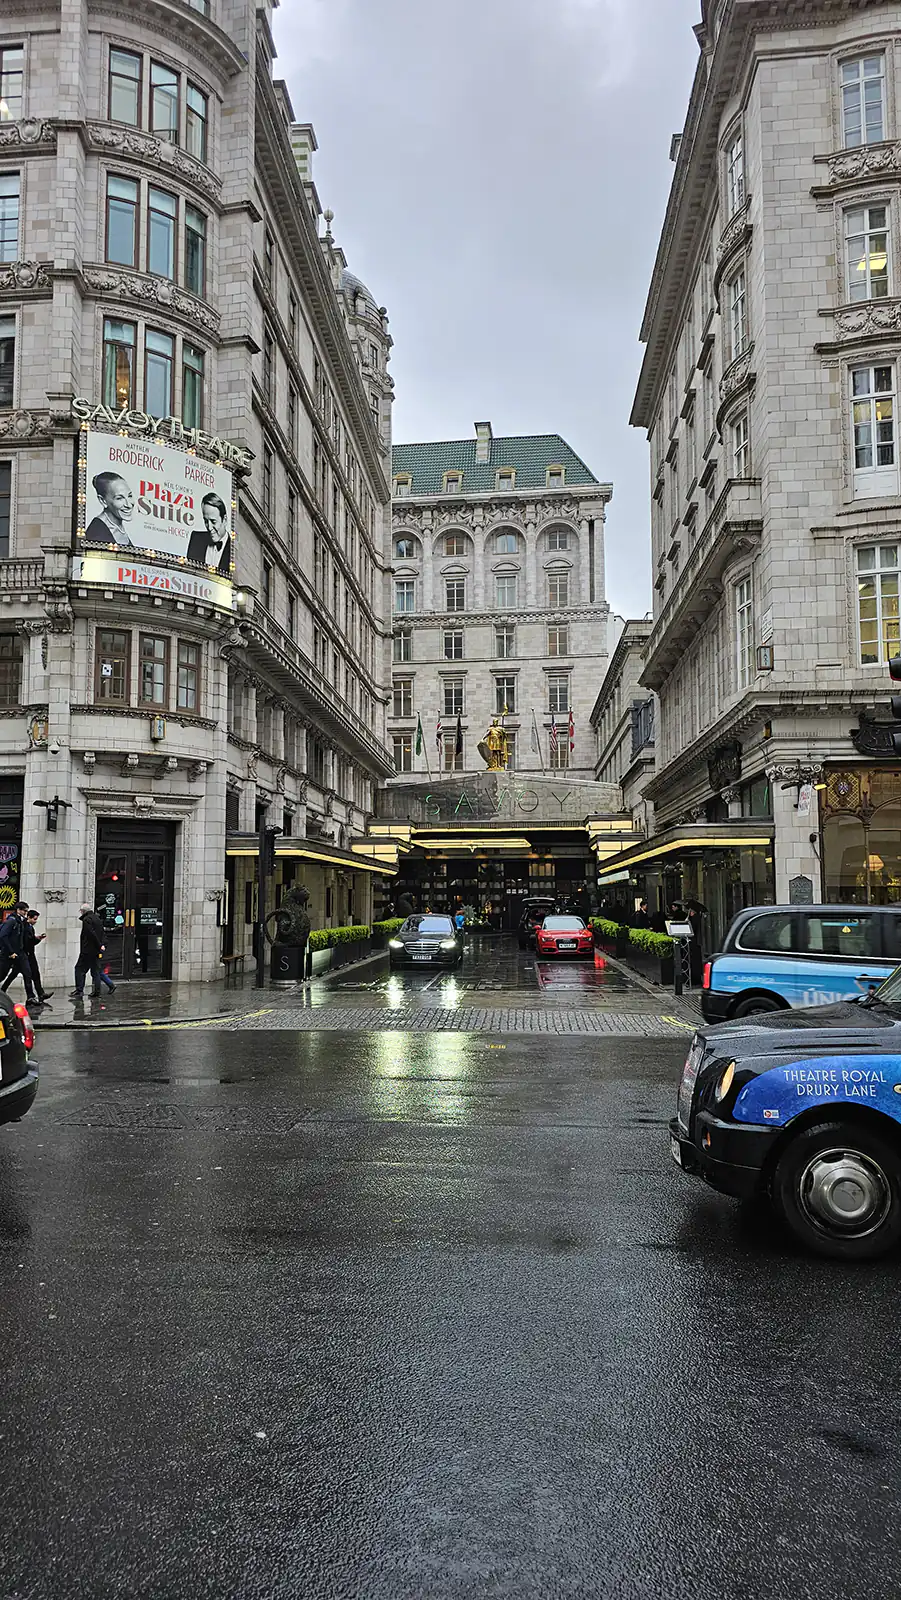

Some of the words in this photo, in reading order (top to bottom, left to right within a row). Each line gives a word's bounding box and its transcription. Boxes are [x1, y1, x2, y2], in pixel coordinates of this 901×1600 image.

[72, 397, 163, 432] SAVOY
[167, 415, 250, 467] THEATRE
[109, 447, 164, 472] BRODERICK
[125, 443, 150, 453] MATTHEW
[184, 466, 215, 489] PARKER
[140, 480, 194, 509] Plaza
[138, 497, 194, 527] Suite
[168, 526, 189, 539] HICKEY
[118, 567, 170, 589] Plaza
[171, 575, 212, 599] Suite
[425, 788, 572, 815] SAVOY
[279, 955, 290, 972] S
[783, 1069, 837, 1082] THEATRE
[842, 1070, 887, 1083] ROYAL
[796, 1083, 840, 1096] DRURY
[844, 1084, 877, 1097] LANE
